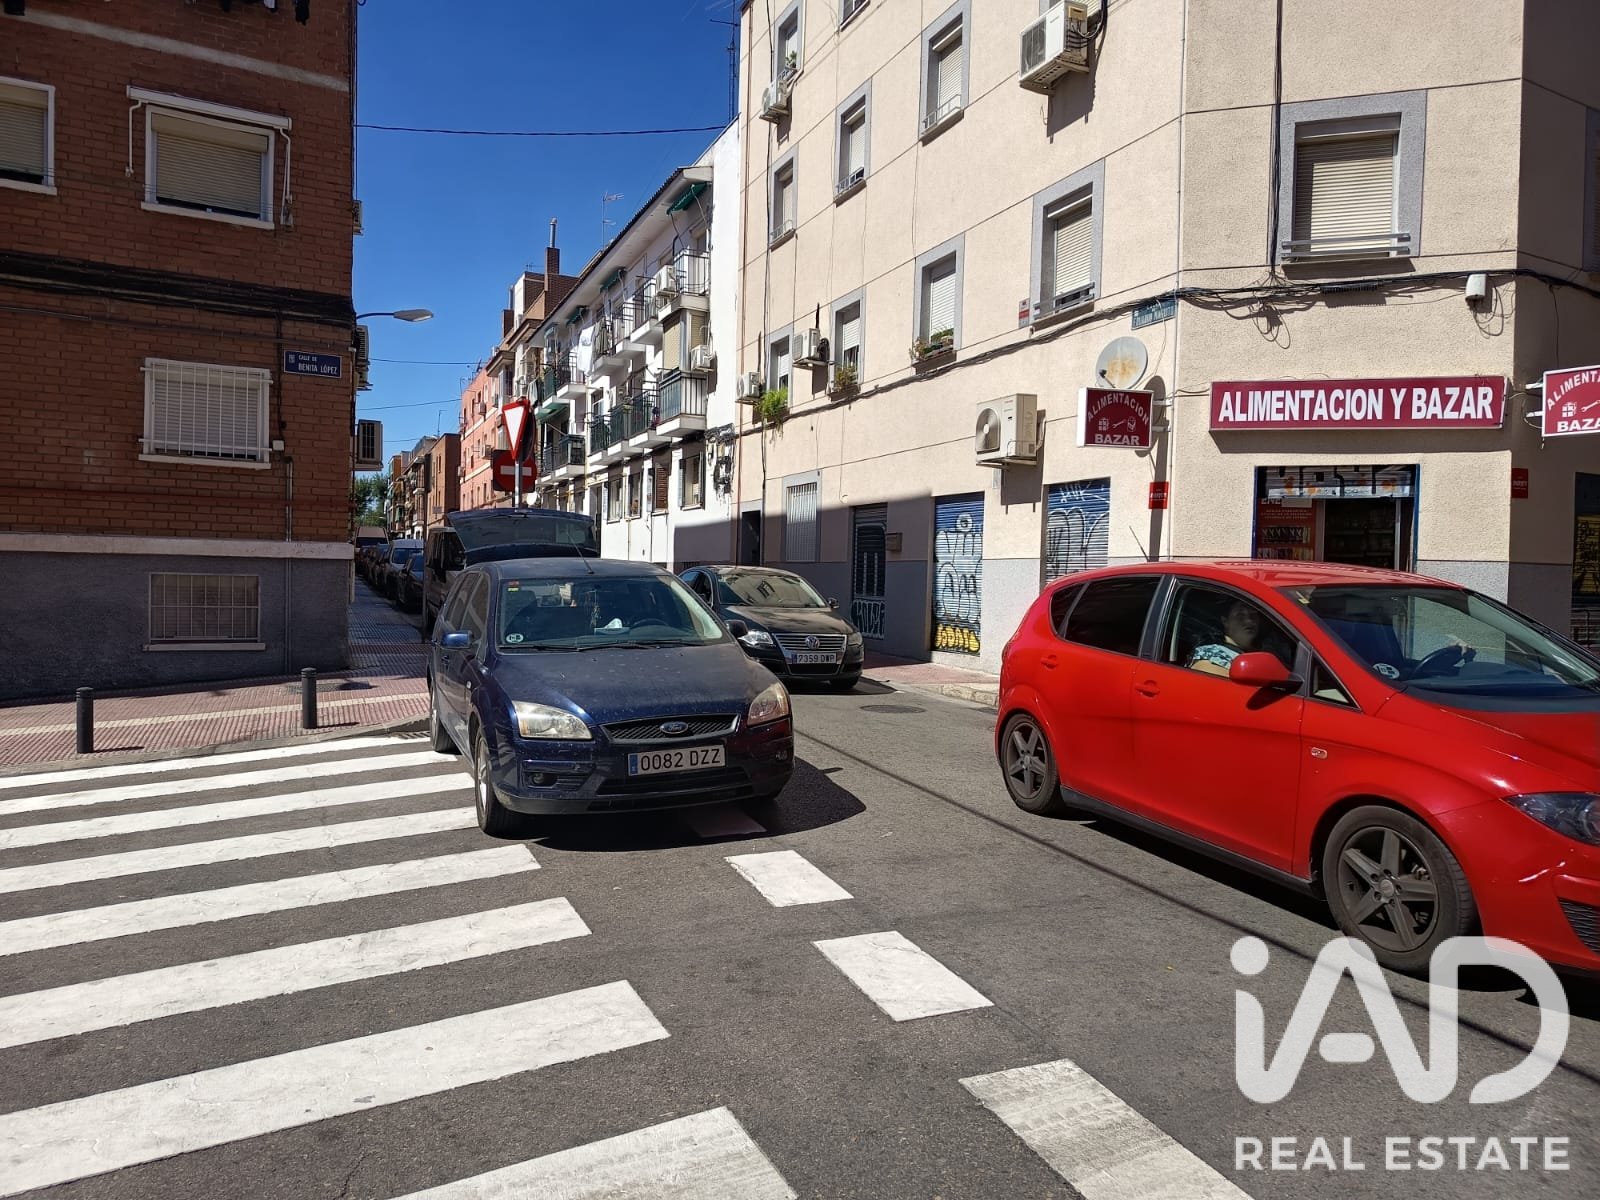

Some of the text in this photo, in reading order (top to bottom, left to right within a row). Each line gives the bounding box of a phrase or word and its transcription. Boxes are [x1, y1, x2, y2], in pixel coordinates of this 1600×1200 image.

[298, 363, 338, 375] BENITA LÓPEZ
[1218, 386, 1494, 422] ALIMENTACION Y BAZAR
[1547, 370, 1600, 411] ALIMENT
[1087, 392, 1150, 425] ALIMENTACION
[1095, 433, 1140, 446] BAZAR
[640, 748, 721, 771] 0082 DZZ
